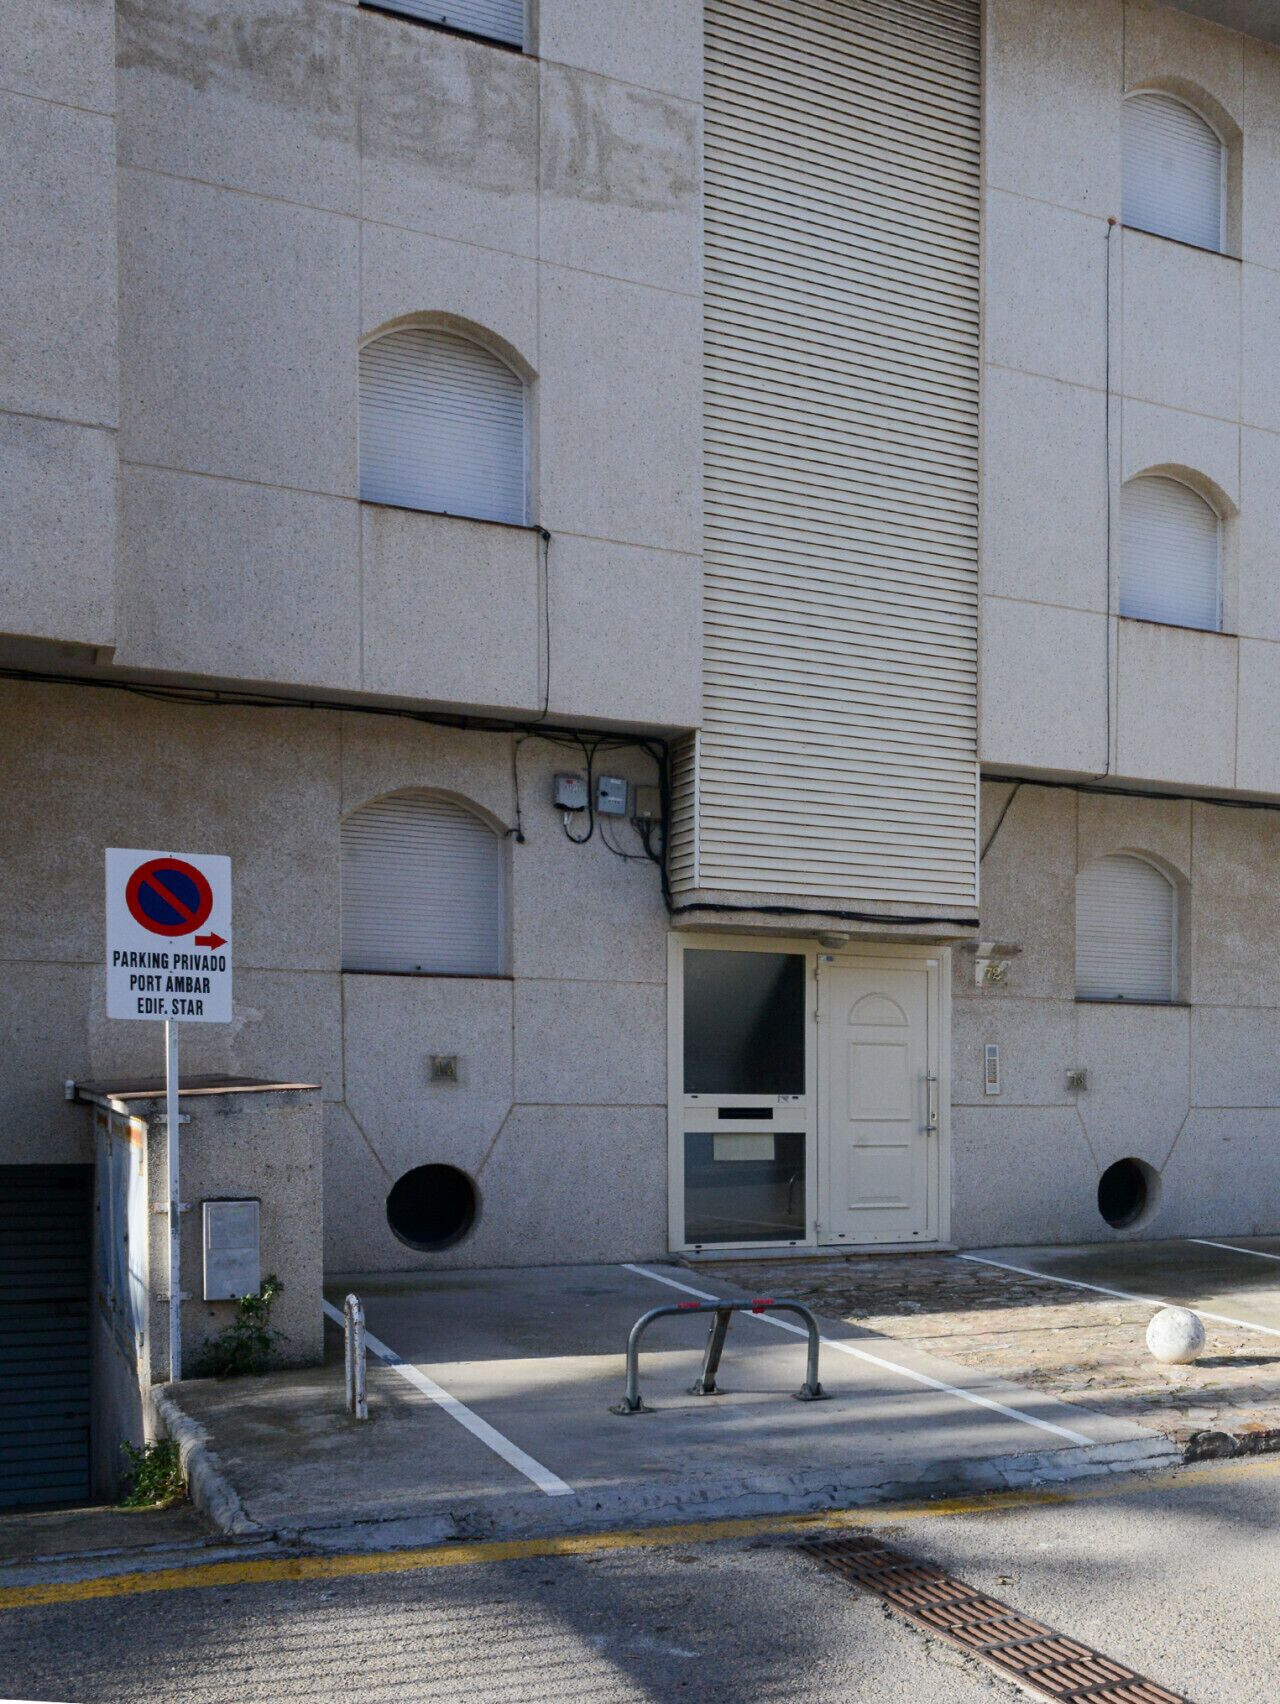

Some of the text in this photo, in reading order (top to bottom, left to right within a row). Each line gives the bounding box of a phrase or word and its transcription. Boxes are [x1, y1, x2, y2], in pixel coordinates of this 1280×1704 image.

[113, 950, 226, 972] PARKING PRIVADO
[130, 974, 211, 994] PORT AMBAR
[137, 997, 204, 1016] EDIF. STAR
